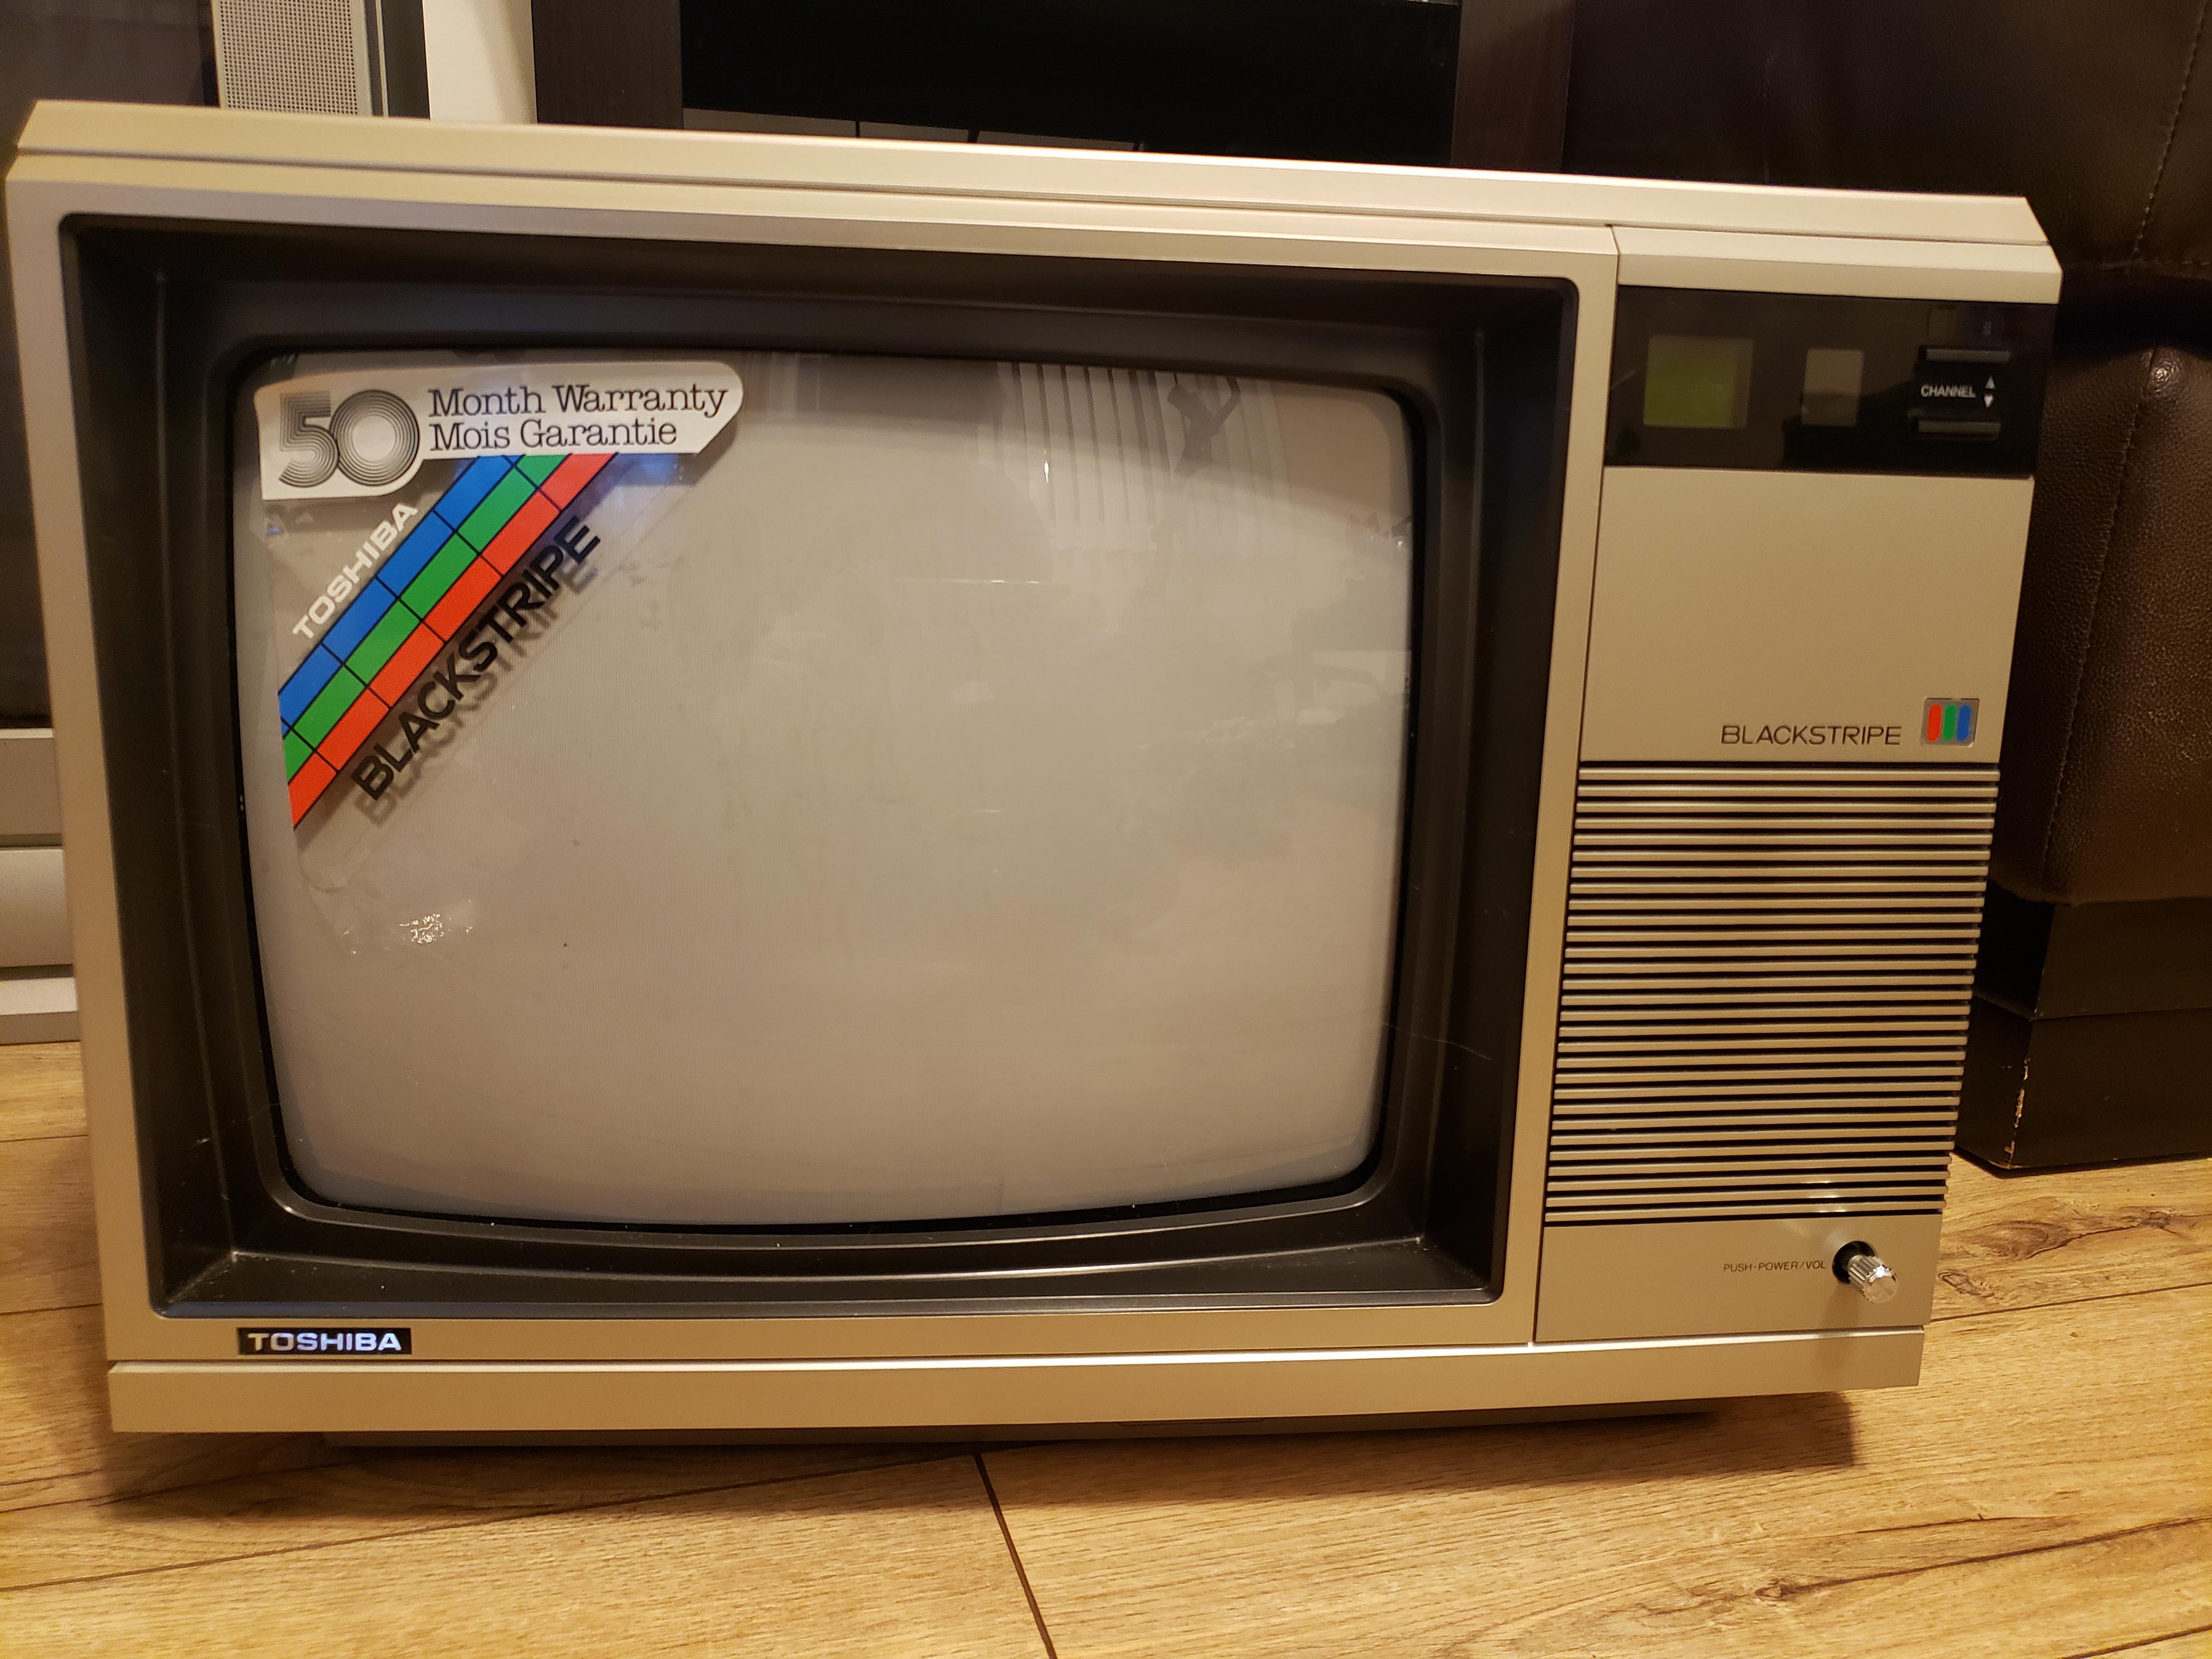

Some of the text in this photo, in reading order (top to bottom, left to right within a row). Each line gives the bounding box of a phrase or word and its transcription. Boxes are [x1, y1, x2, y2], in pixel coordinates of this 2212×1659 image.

[427, 383, 729, 417] Month Warranty
[1921, 383, 1976, 398] CHANNEL
[279, 390, 420, 488] 50
[429, 418, 678, 451] Mois Garantie
[292, 502, 418, 639] TOSHIBA
[351, 516, 601, 800] BLACKSTRIPE
[1721, 725, 1901, 745] BLACKSTRIPE
[247, 1333, 402, 1351] TOSHIBA
